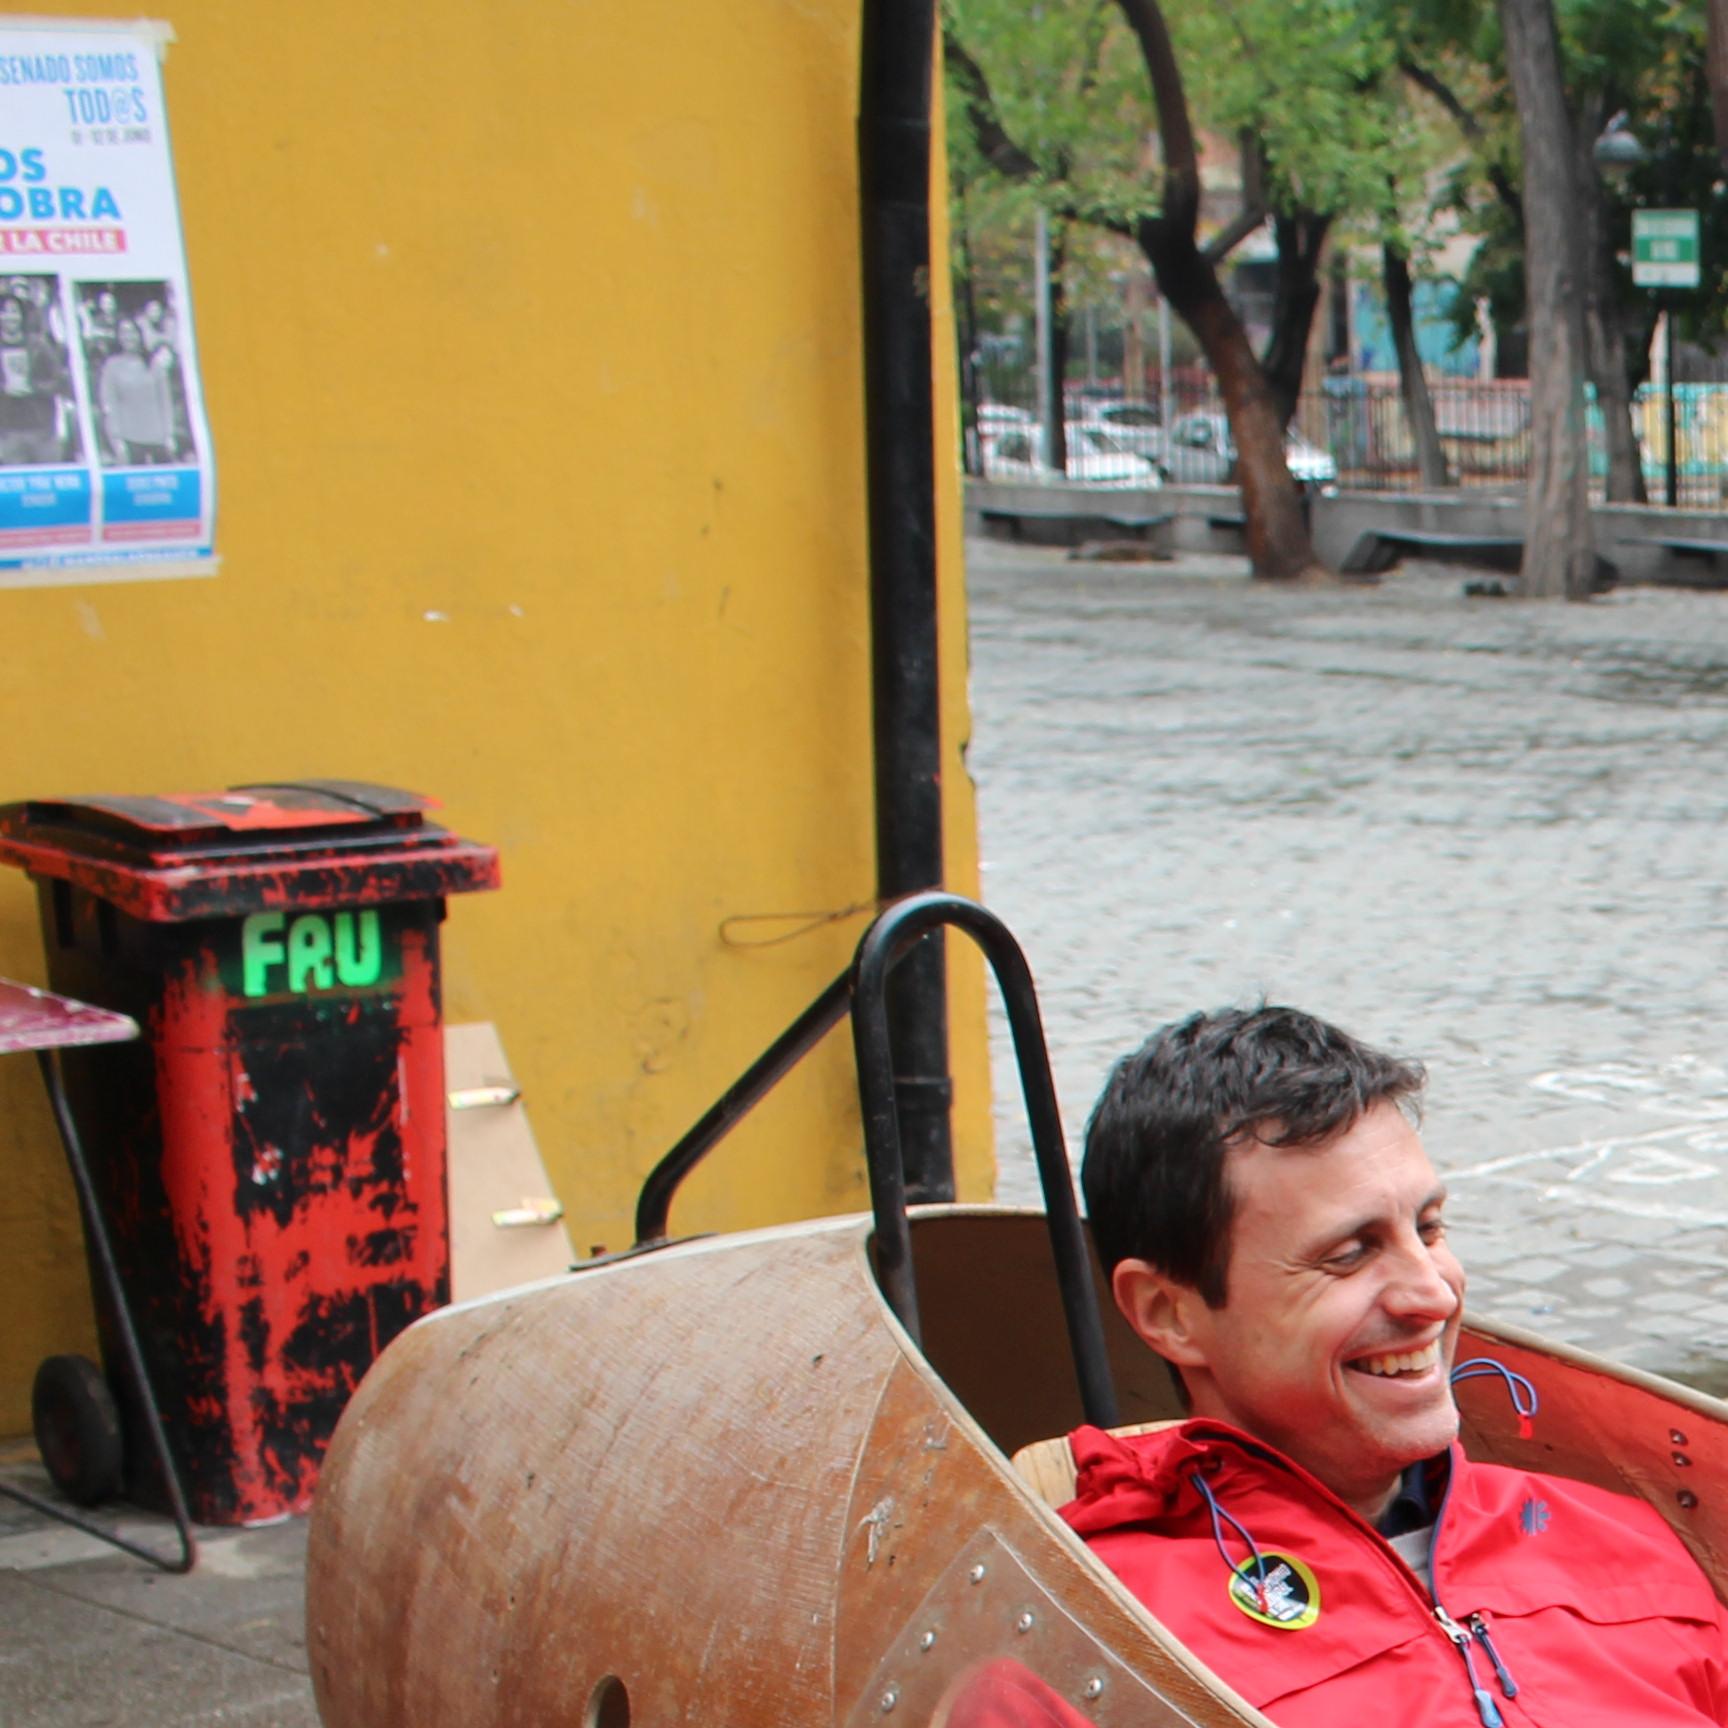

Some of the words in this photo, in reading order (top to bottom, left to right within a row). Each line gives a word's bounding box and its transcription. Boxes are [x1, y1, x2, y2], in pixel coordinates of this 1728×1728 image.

[74, 52, 139, 82] SOMOS
[63, 85, 148, 124] TOD@S
[12, 231, 45, 251] LA
[48, 230, 116, 250] CHILE
